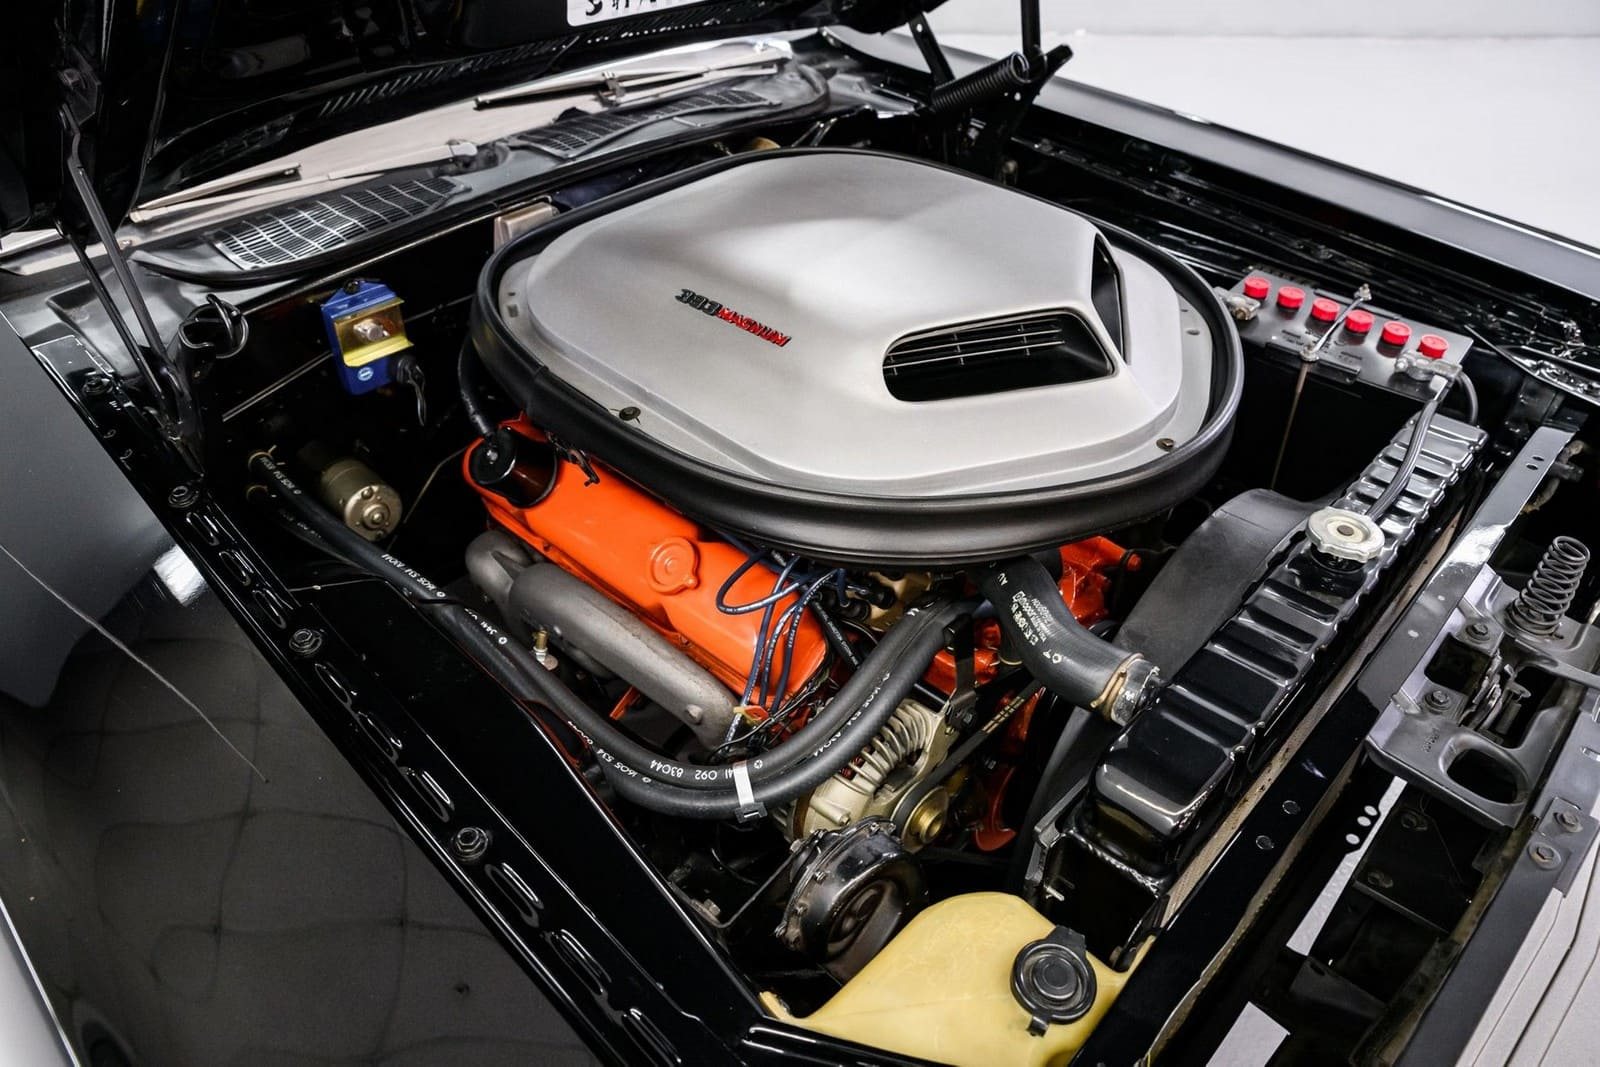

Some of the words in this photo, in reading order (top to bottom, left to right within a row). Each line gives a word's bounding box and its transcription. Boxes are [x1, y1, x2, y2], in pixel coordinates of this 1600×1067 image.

[715, 306, 792, 347] MAGNUM
[649, 759, 684, 778] 83044
[694, 769, 718, 781] 092
